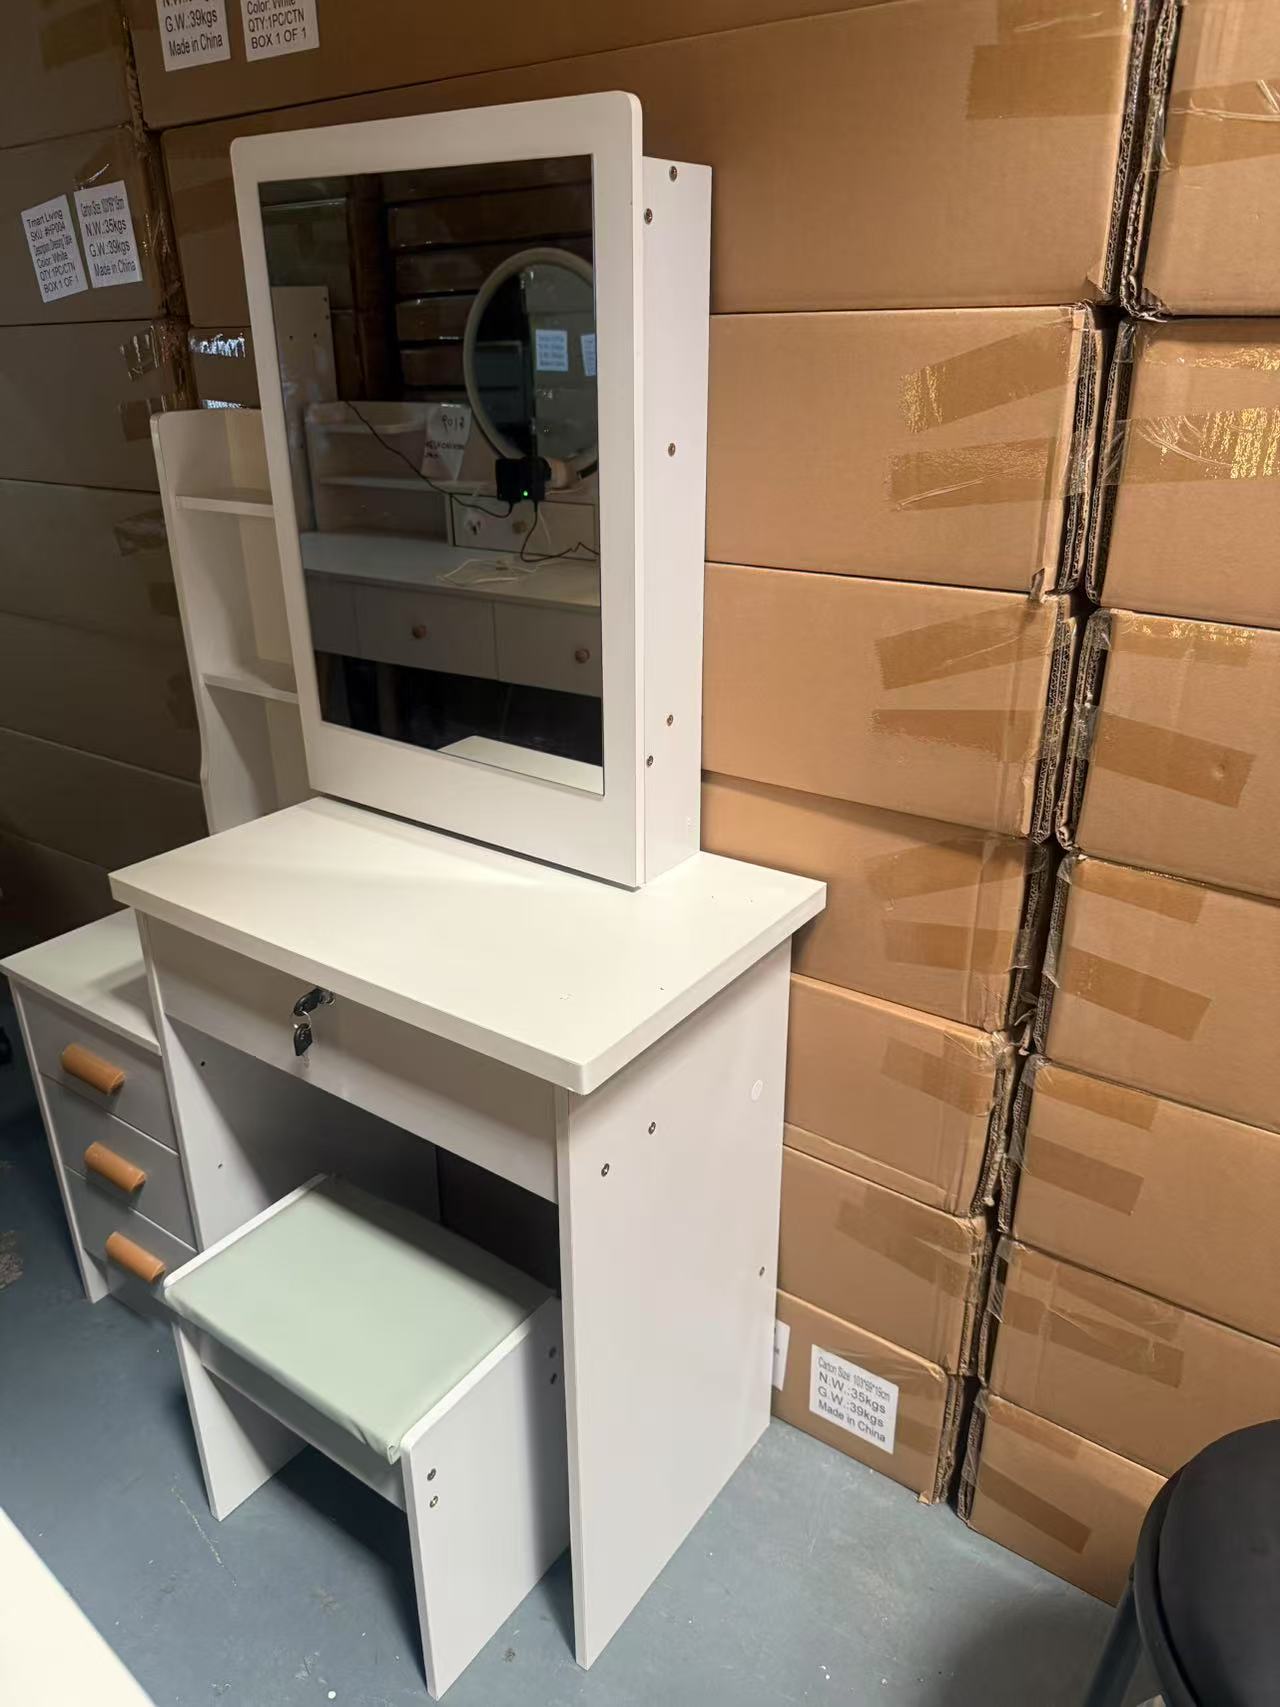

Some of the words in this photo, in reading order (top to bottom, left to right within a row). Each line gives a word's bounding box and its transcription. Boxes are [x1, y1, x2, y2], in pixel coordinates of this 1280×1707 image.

[248, 8, 305, 33] QTY:1PC/CTN
[168, 40, 190, 57] Made
[191, 37, 199, 53] in
[200, 33, 223, 51] China
[251, 33, 273, 50] BOX
[275, 31, 281, 45] 1
[283, 28, 298, 43] OF
[302, 26, 307, 39] 1
[45, 209, 64, 222] Living
[52, 251, 69, 264] White
[93, 262, 111, 277] Made
[111, 262, 118, 274] in
[118, 258, 137, 273] China
[43, 279, 59, 294] BOX
[63, 275, 73, 287] OF
[817, 1355, 837, 1375] Carton
[817, 1399, 845, 1421] Made
[846, 1414, 856, 1427] in
[856, 1420, 887, 1443] China
